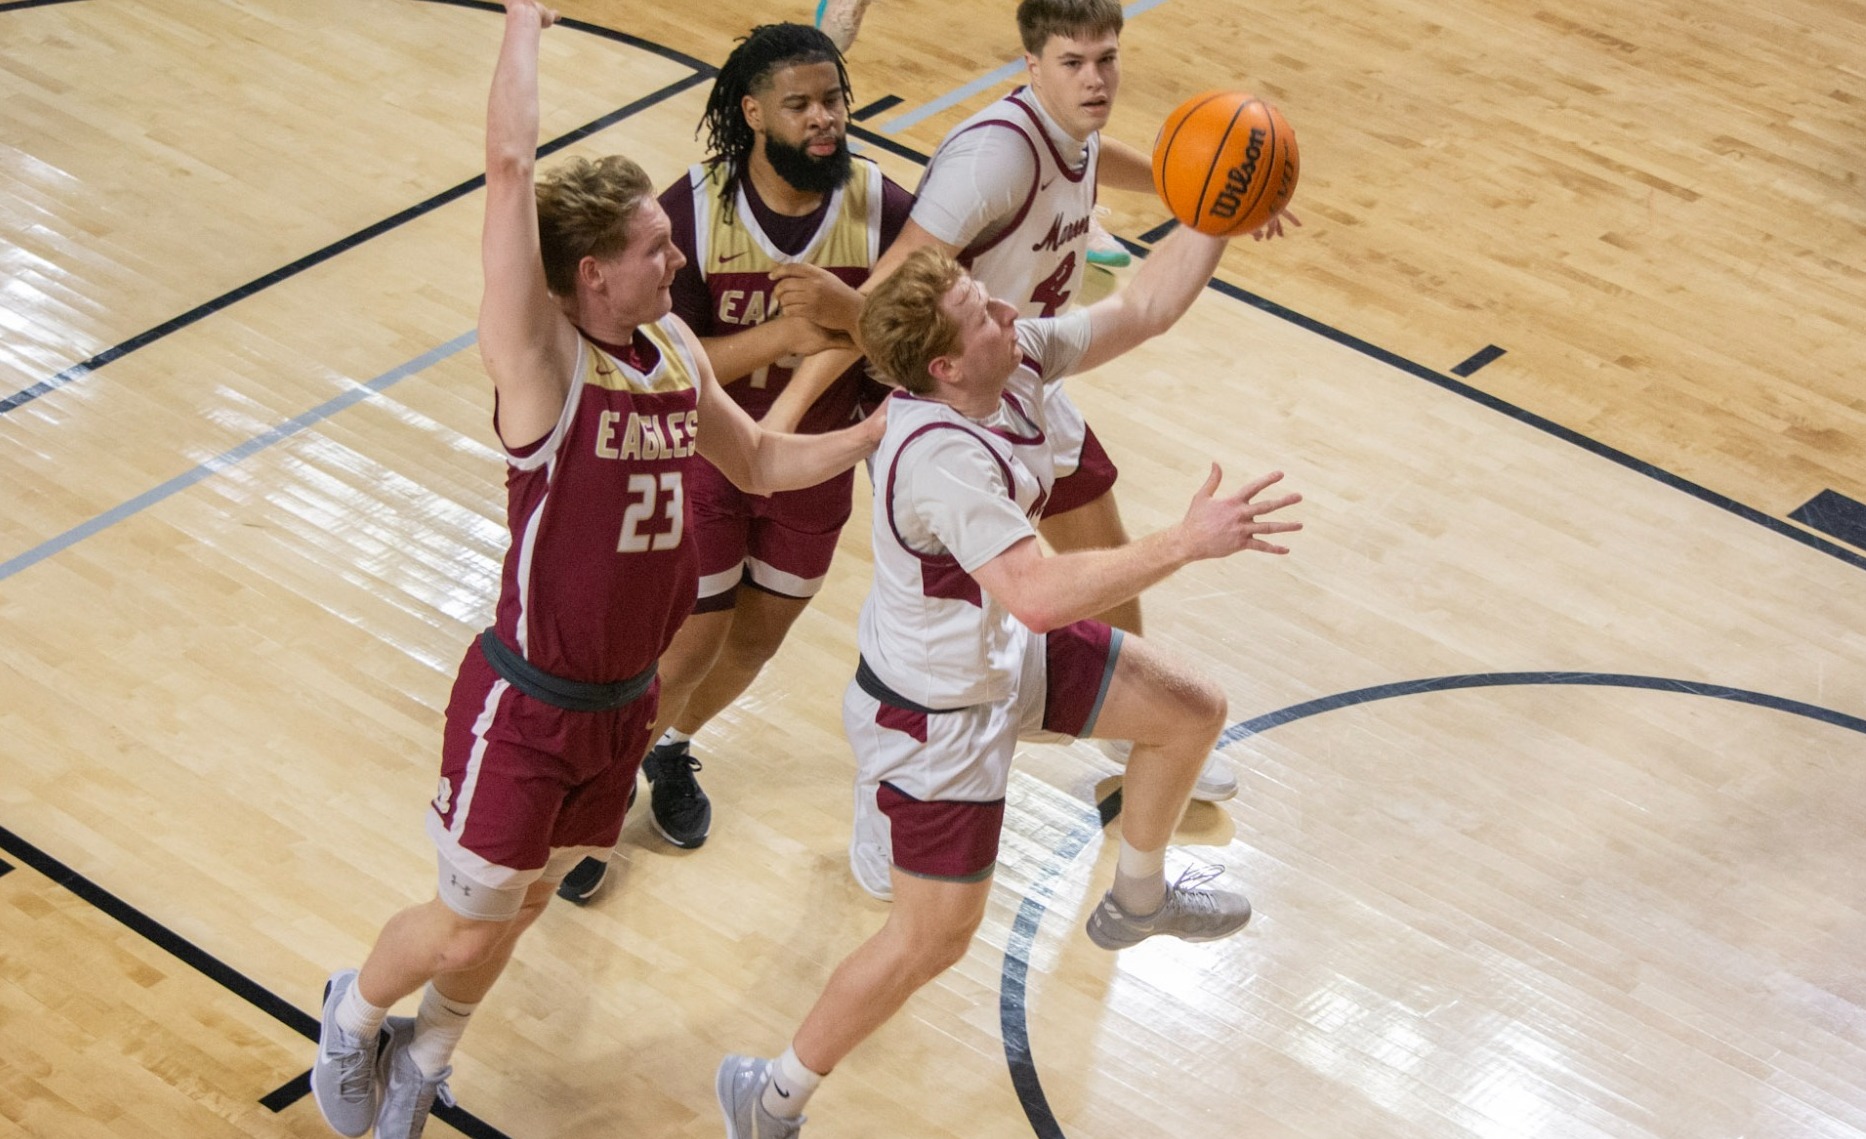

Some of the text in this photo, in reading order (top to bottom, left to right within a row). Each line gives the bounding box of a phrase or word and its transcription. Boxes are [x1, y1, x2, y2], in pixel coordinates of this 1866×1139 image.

[1210, 128, 1266, 219] Wilson
[595, 409, 699, 461] EAGLES
[616, 471, 684, 553] 23
